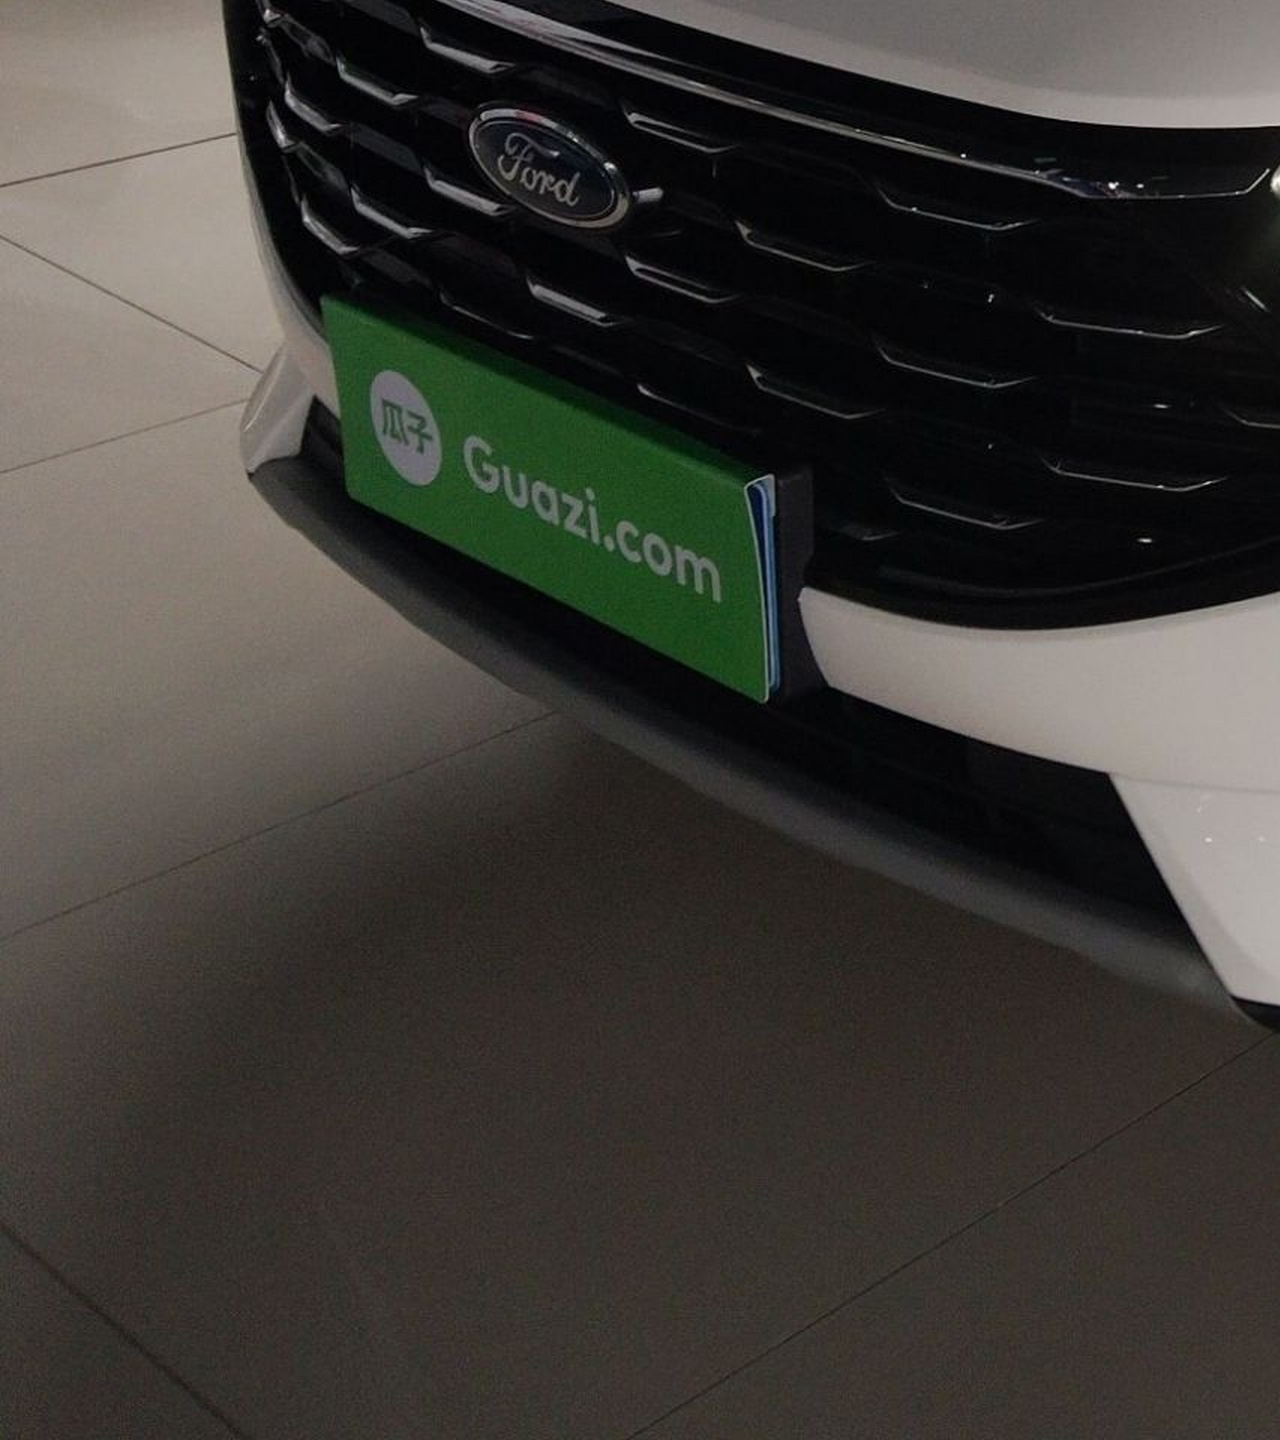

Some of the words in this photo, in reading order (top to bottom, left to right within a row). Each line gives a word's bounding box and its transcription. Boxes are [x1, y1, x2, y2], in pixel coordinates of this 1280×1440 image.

[497, 132, 581, 207] Ford
[381, 398, 433, 454] 瓜子
[463, 434, 722, 603] Guazi.com
